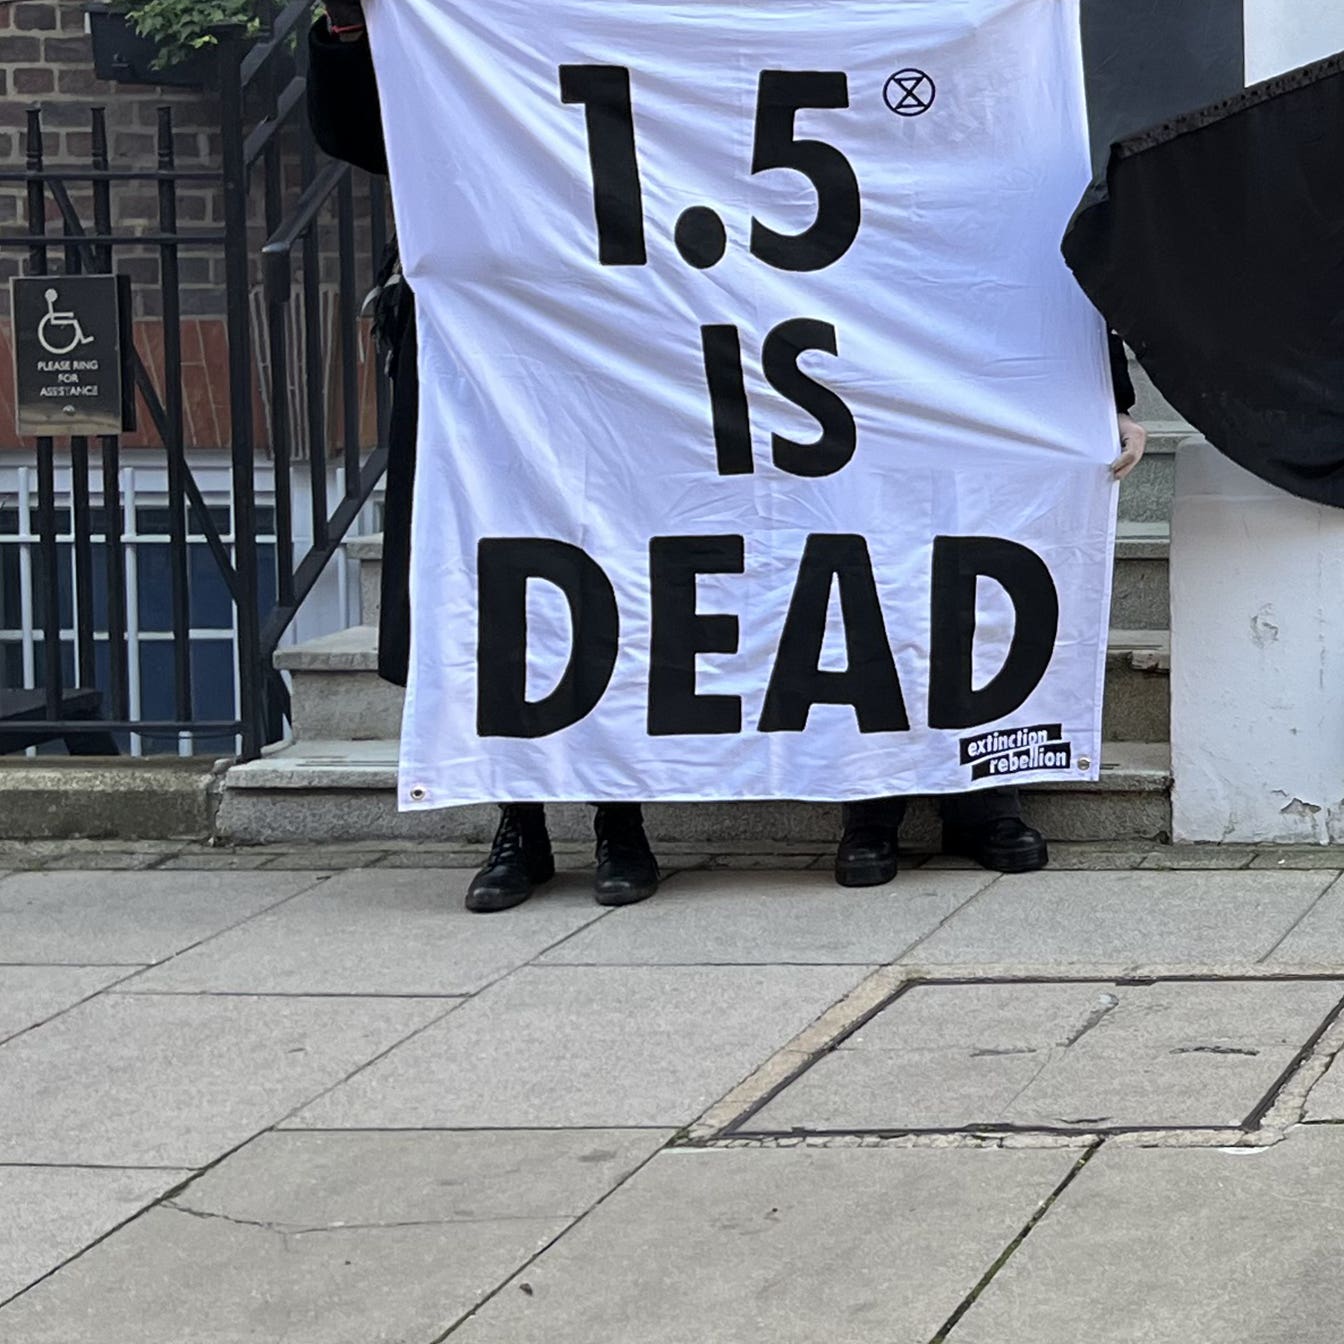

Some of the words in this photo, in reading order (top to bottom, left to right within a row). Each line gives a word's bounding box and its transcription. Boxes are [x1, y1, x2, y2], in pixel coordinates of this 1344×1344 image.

[558, 64, 861, 272] 1.5
[37, 360, 71, 371] PLEASE
[73, 359, 99, 370] RING
[57, 373, 79, 384] FOR
[39, 385, 98, 396] ASSISTANCE
[700, 318, 857, 478] IS
[476, 533, 1060, 738] DEAD
[967, 728, 1048, 757] extinction
[988, 744, 1068, 774] rebellion
